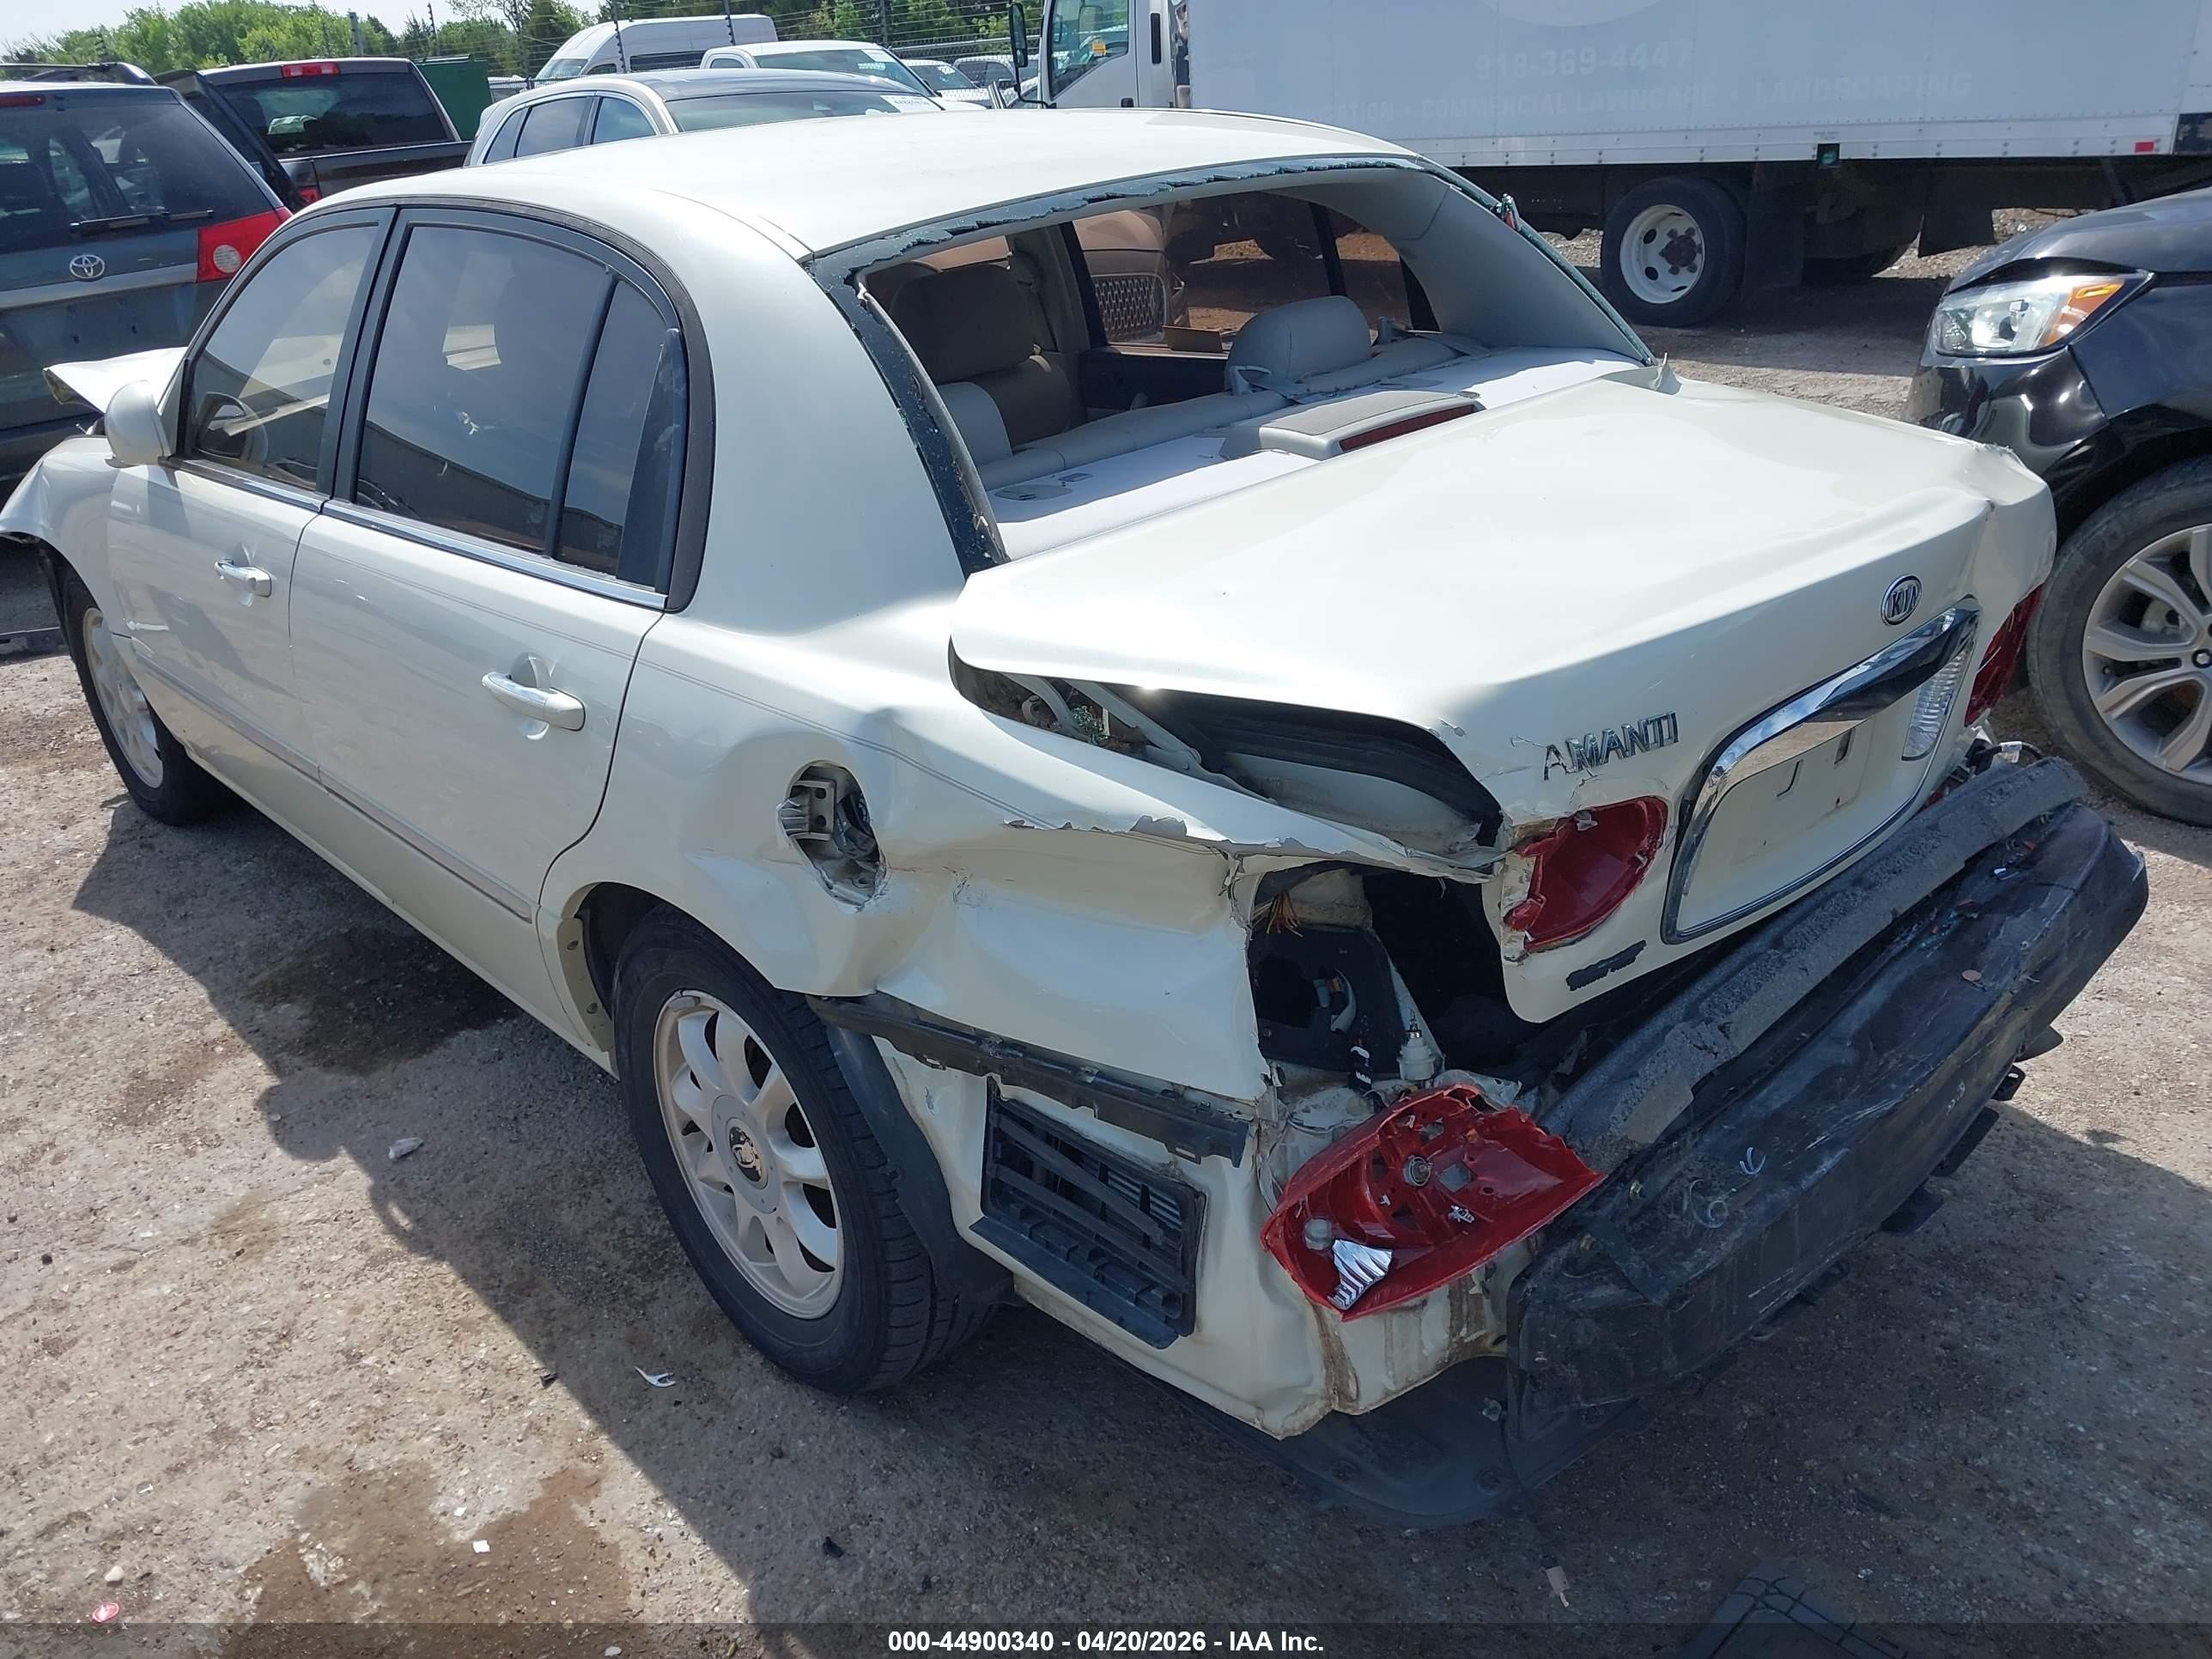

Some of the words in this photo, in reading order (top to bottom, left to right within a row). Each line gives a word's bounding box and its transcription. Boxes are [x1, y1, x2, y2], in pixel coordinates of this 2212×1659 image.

[1475, 40, 1692, 82] 918-369-4447
[1885, 581, 1918, 619] KIA
[1543, 711, 1679, 781] AMANTI
